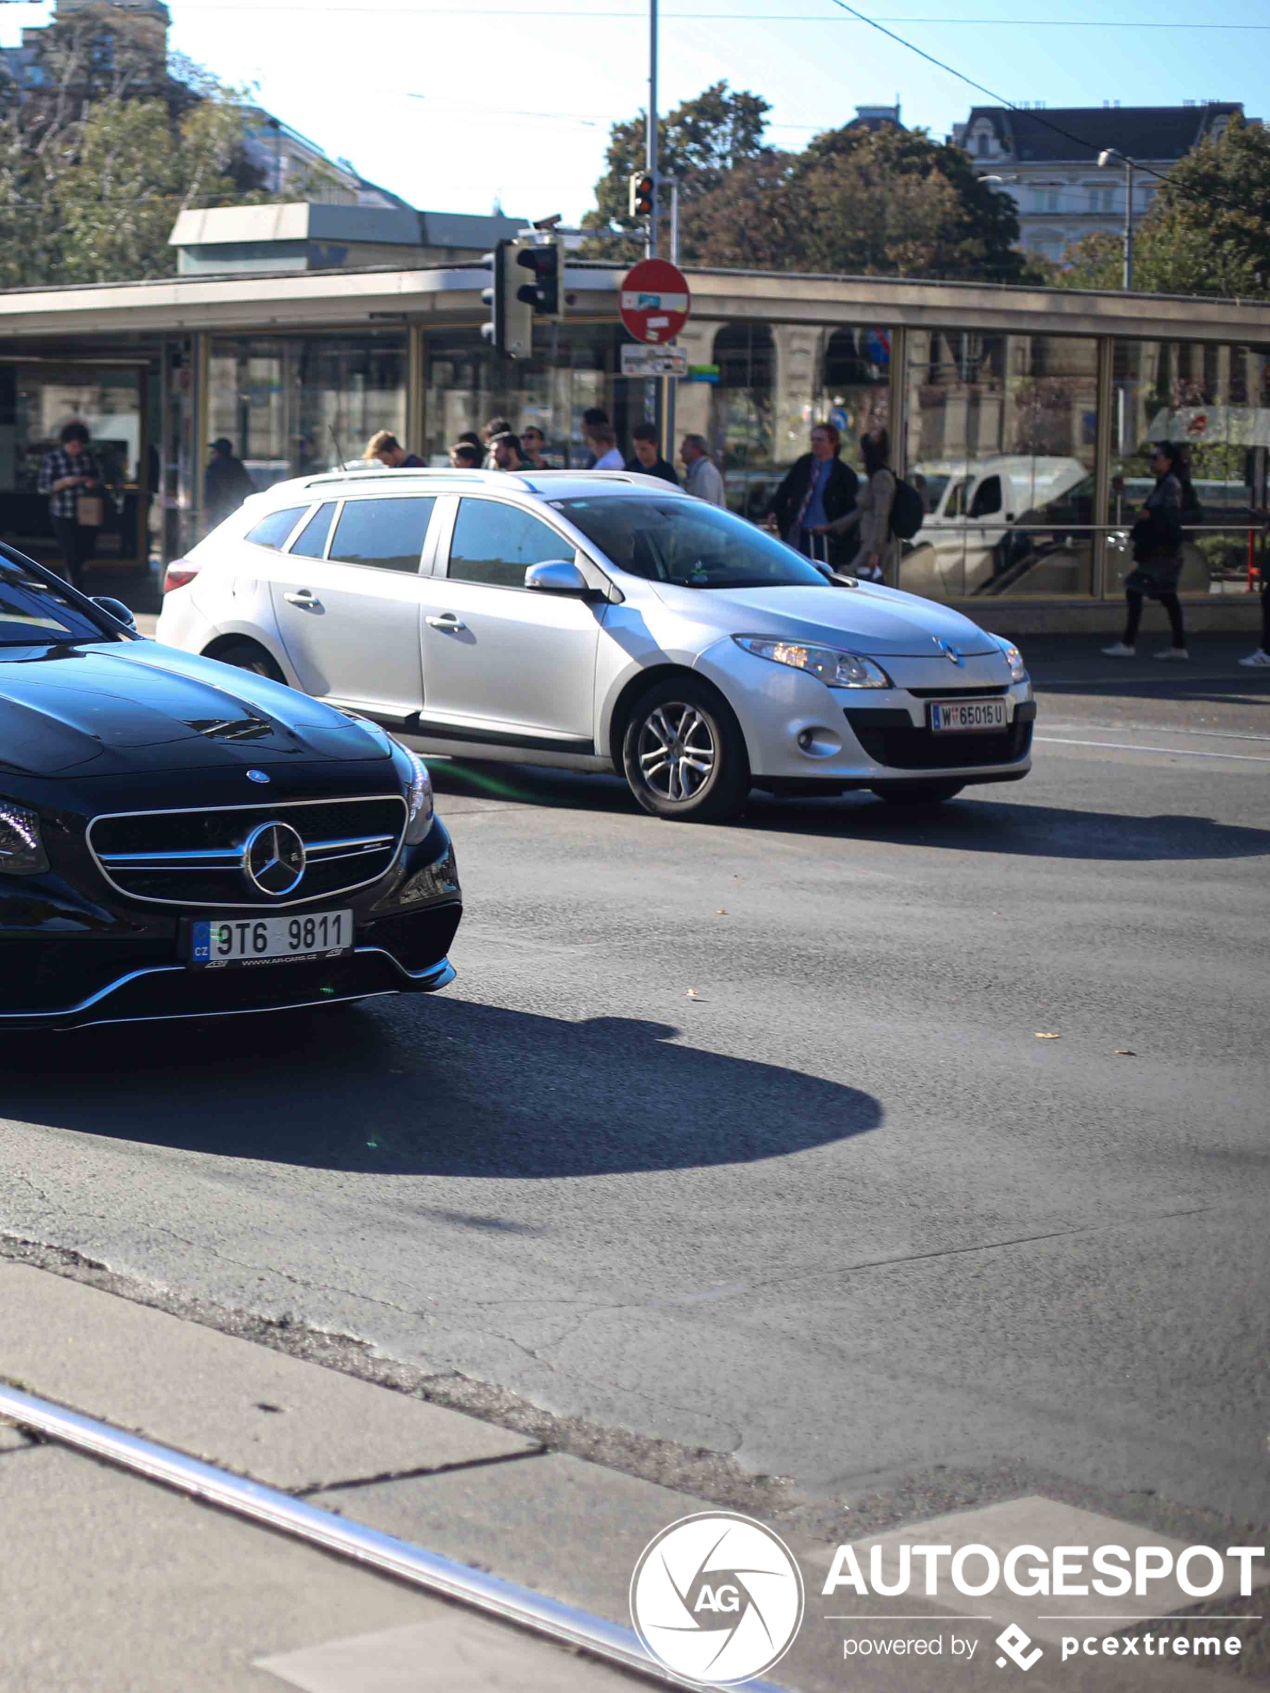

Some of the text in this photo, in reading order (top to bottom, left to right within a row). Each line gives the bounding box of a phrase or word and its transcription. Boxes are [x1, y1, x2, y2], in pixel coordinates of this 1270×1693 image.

[217, 914, 341, 955] 9T6 9811
[194, 947, 209, 957] CZ
